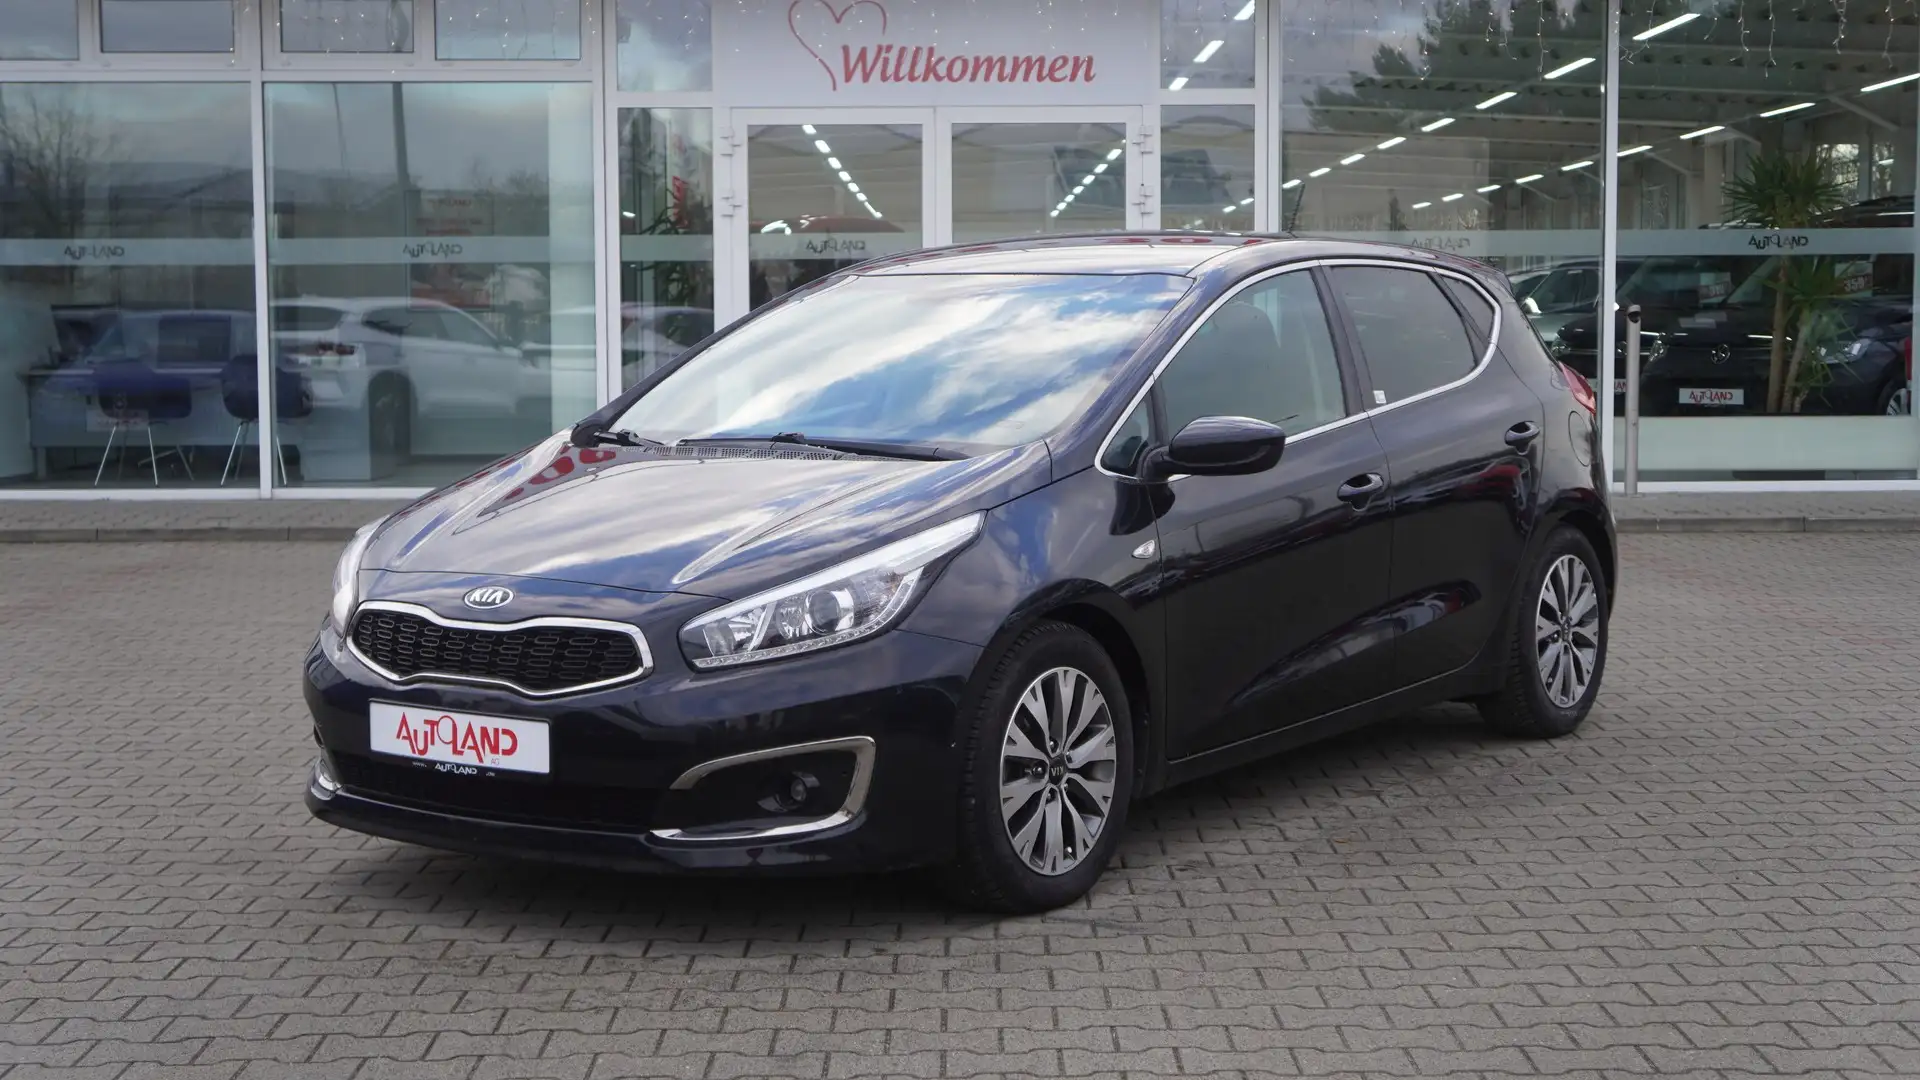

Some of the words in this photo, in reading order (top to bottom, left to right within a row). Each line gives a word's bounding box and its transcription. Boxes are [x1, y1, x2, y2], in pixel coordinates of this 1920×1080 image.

[841, 44, 1096, 83] Willkommen
[1748, 233, 1809, 249] AUTOLAND
[469, 588, 504, 604] KIA
[396, 711, 518, 763] AUTOLAND
[435, 763, 477, 775] AUTOLAND
